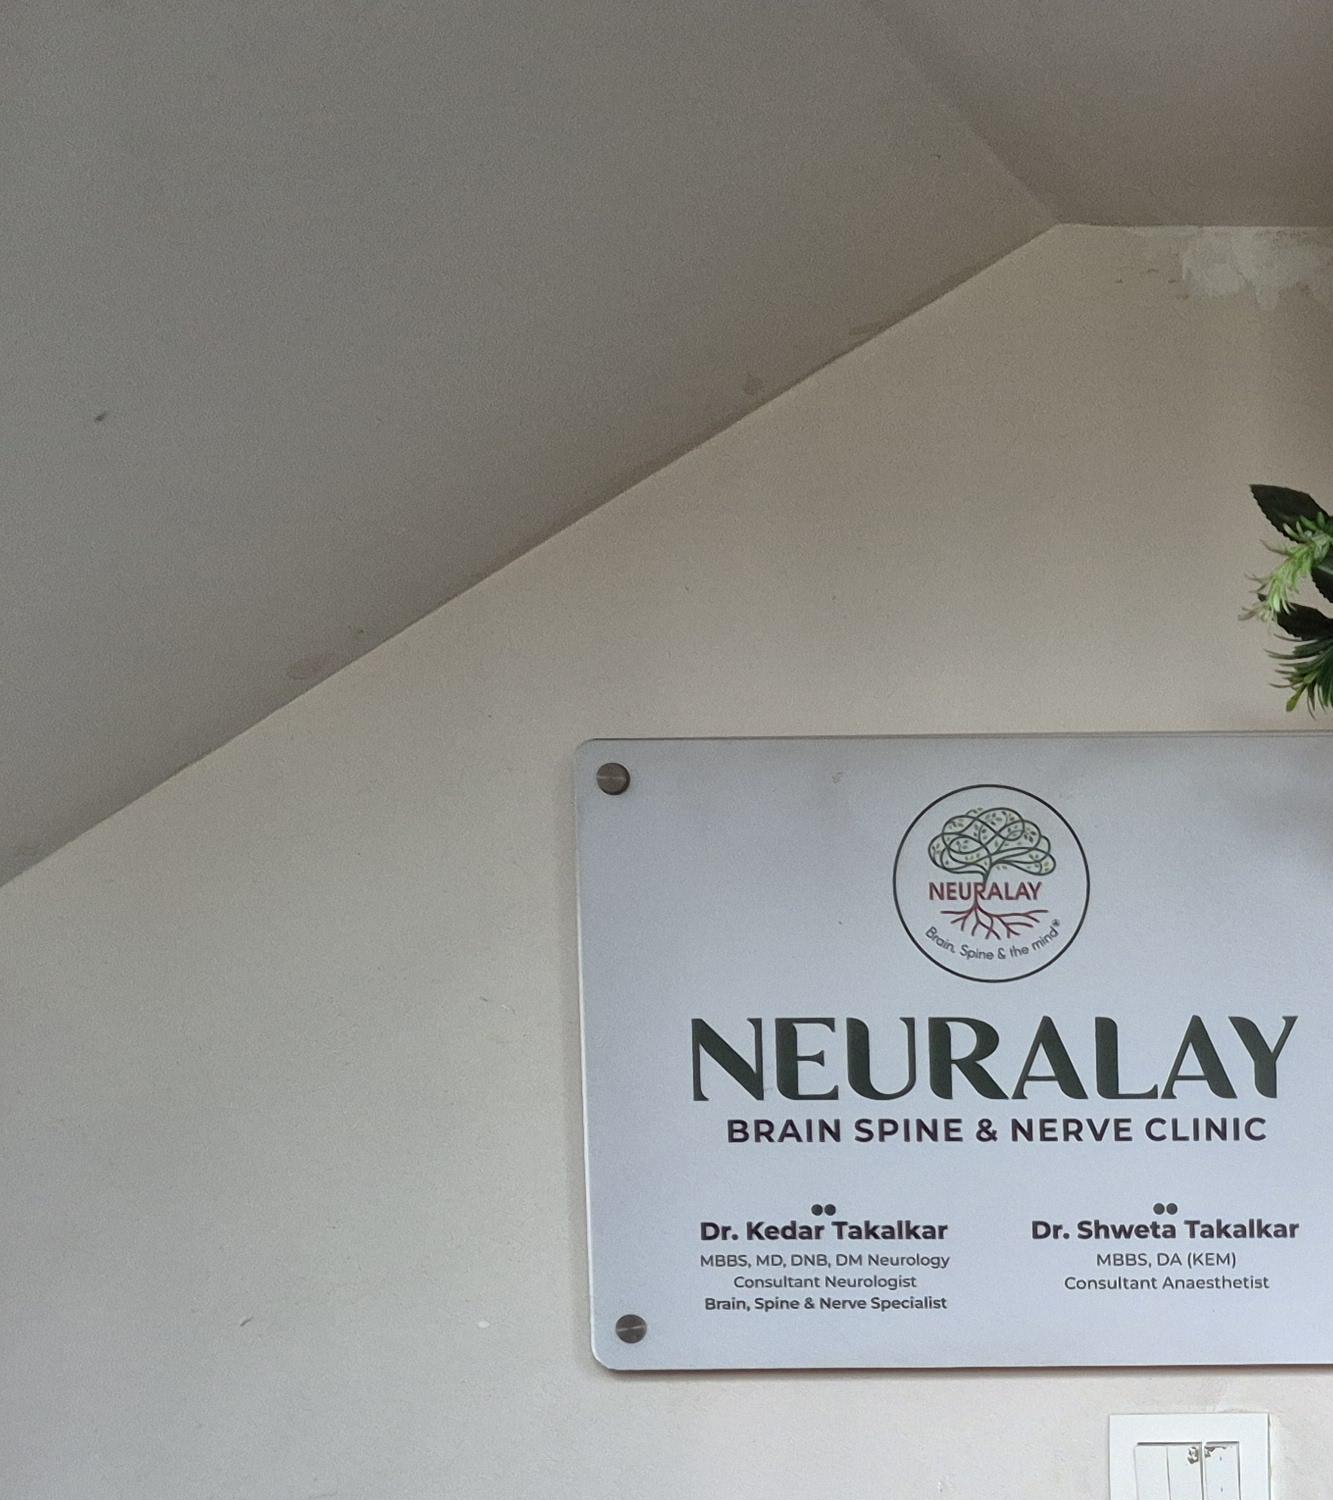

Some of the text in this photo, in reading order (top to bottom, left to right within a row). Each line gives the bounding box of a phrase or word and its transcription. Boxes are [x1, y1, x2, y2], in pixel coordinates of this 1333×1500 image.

[928, 881, 1042, 900] NEURALAY
[960, 944, 994, 960] Spine
[998, 948, 1006, 958] &
[1010, 946, 1029, 958] the
[691, 1015, 1298, 1101] NEURALAY
[728, 1118, 1266, 1142] BRAIN SPINE & NERVE CLINIC
[701, 1220, 948, 1240] Dr. Kedar Takalkar
[1032, 1219, 1299, 1239] Dr. Shweta Takalkar
[701, 1253, 950, 1269] MBBS, MD, DNB, DM Neurology
[1097, 1253, 1235, 1268] MBBS, DA (KEM)
[734, 1275, 916, 1290] Consultant Neurologist
[1065, 1276, 1269, 1289] Consultant Anaesthetist
[705, 1296, 947, 1312] Brain, Spine & Nerve Specialist
